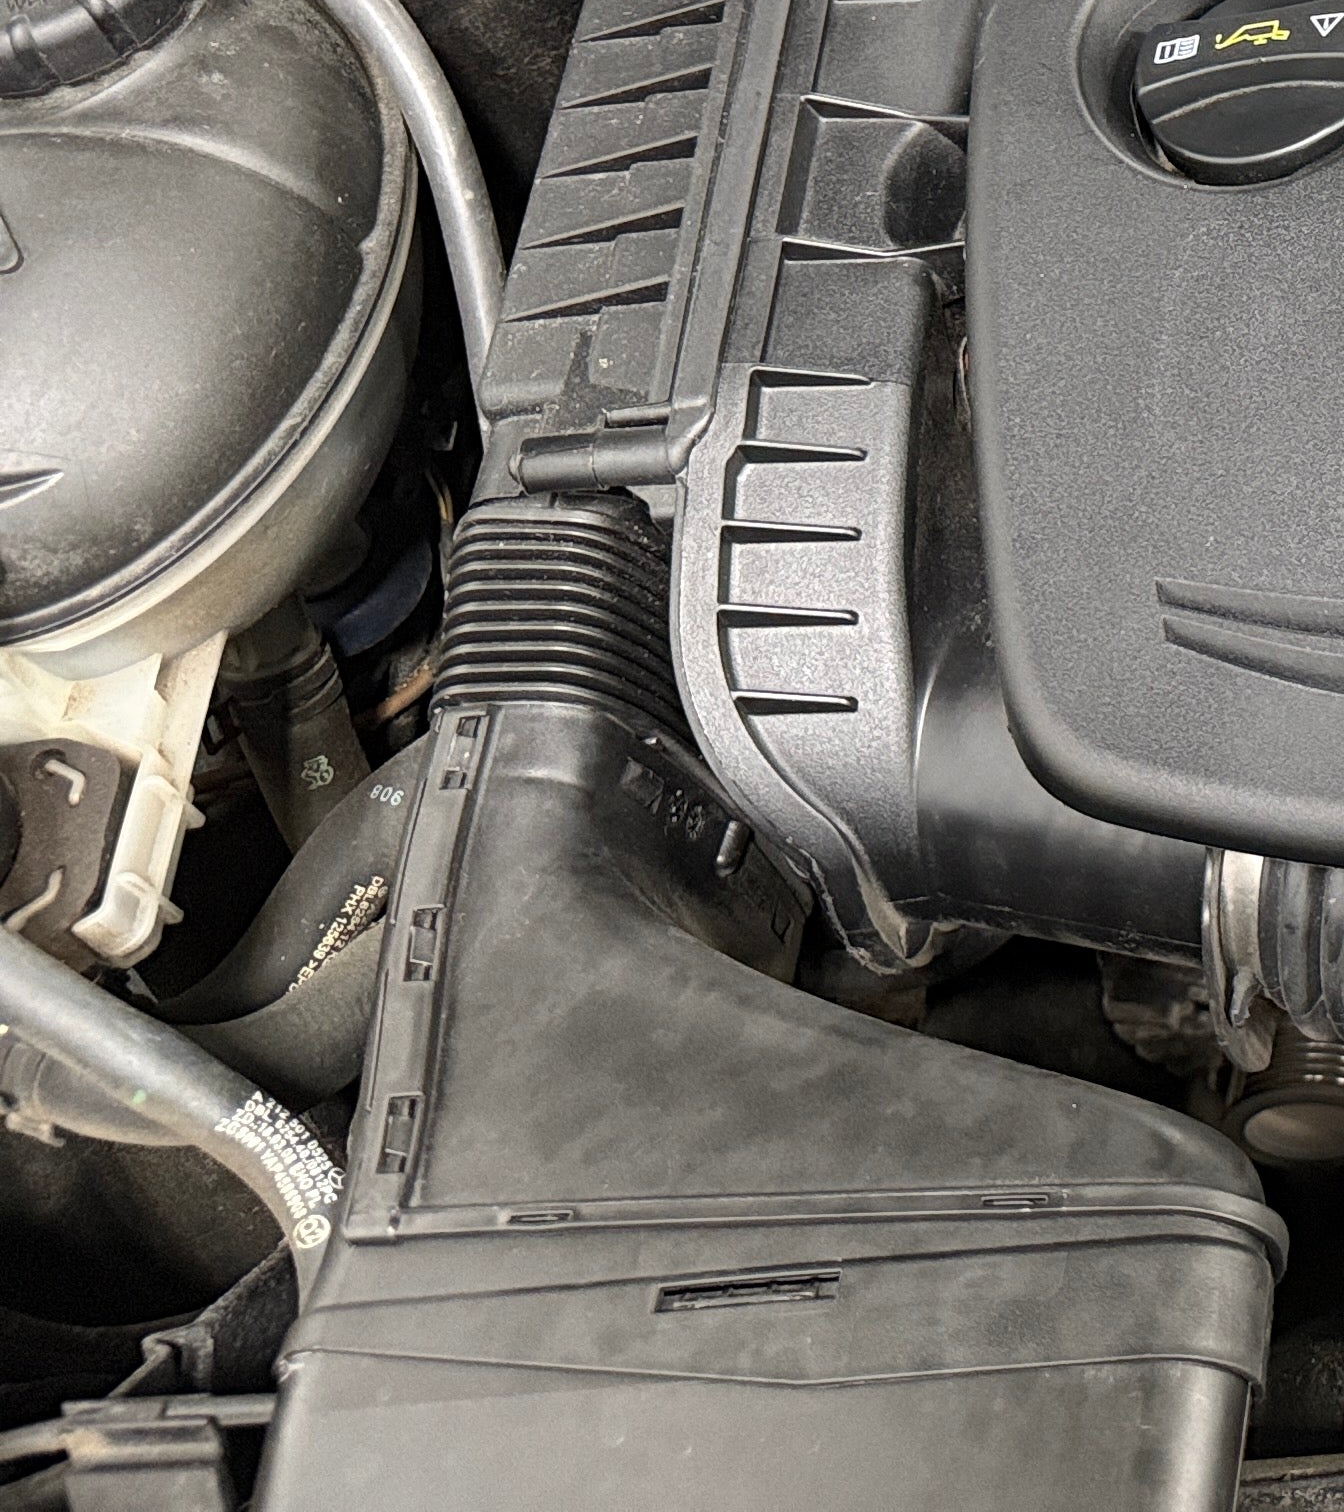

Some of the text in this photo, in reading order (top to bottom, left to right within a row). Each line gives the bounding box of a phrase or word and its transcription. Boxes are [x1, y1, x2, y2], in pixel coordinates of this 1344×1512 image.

[341, 884, 366, 915] PHX
[251, 1090, 264, 1104] A
[265, 1097, 291, 1120] 212
[288, 1118, 311, 1140] 501
